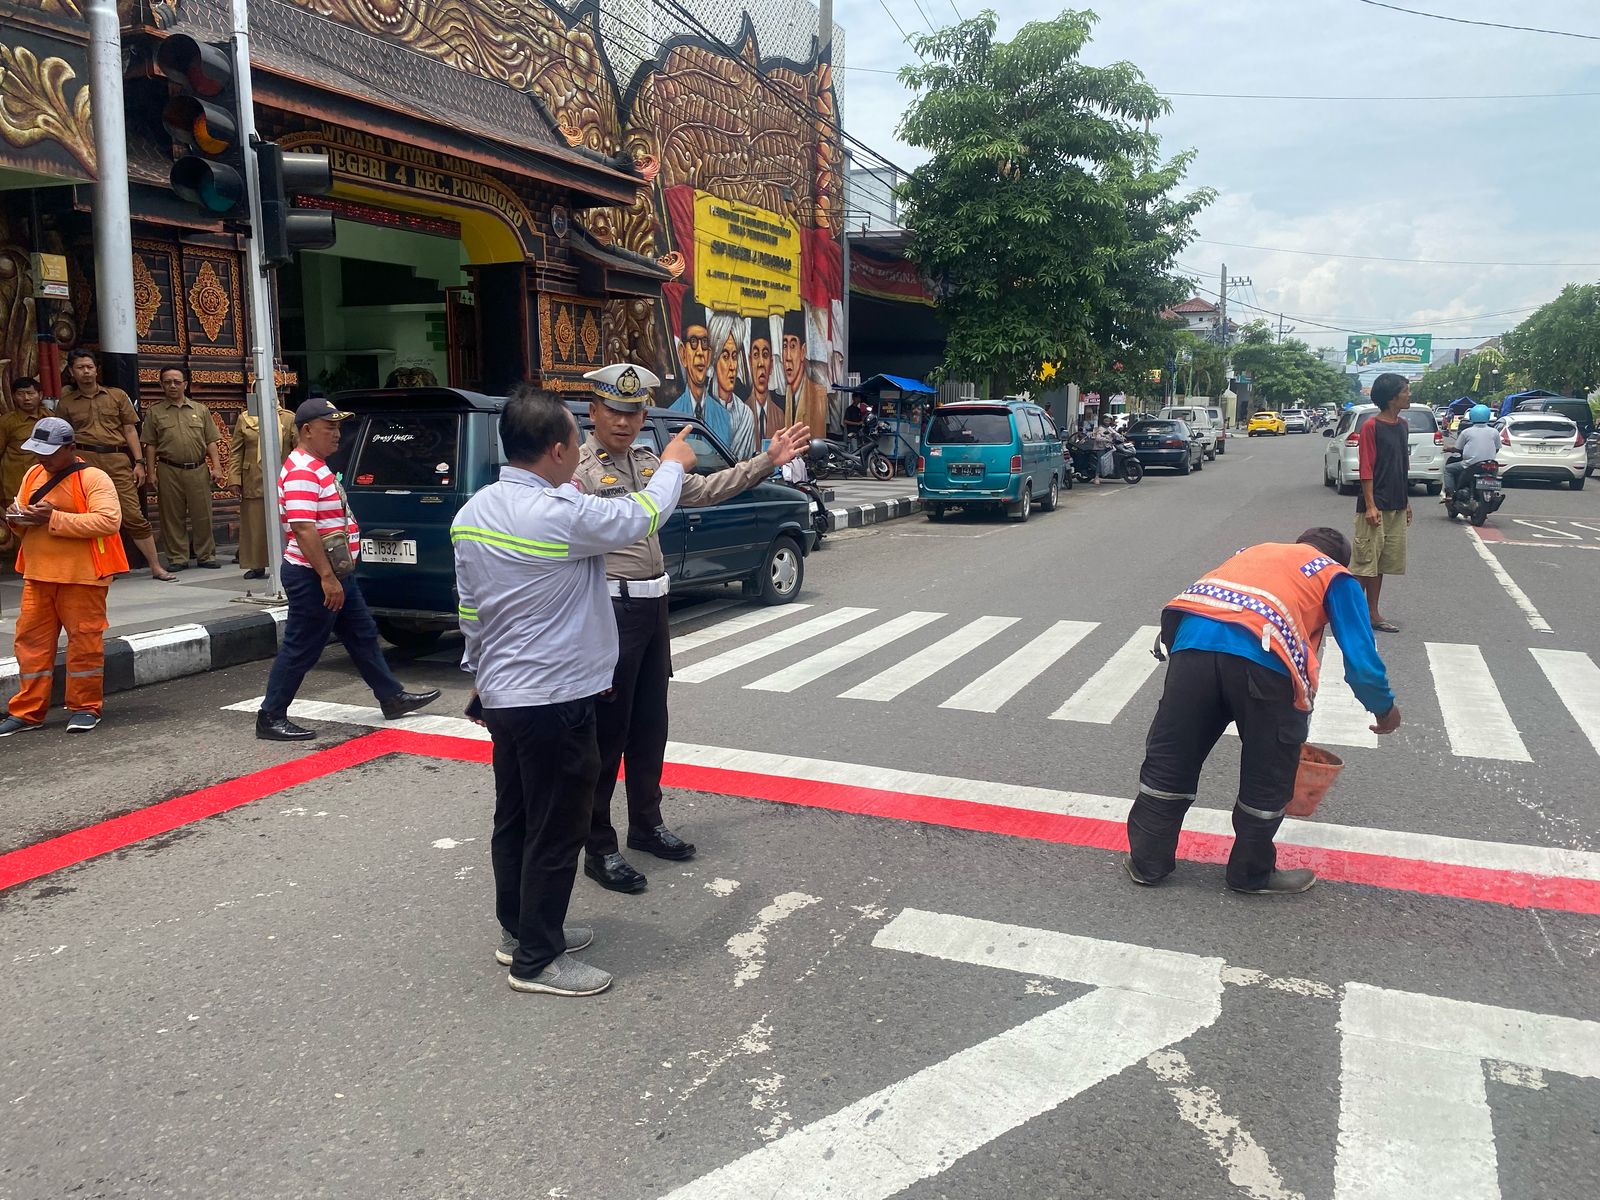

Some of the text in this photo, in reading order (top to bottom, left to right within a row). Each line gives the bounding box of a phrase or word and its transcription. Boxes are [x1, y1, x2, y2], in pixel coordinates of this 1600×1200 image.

[321, 123, 482, 178] WIWARA WIYATA MADYA
[395, 165, 407, 185] 4
[414, 168, 449, 194] KEC.
[452, 178, 524, 228] PONOROGO
[1388, 336, 1417, 347] AYO
